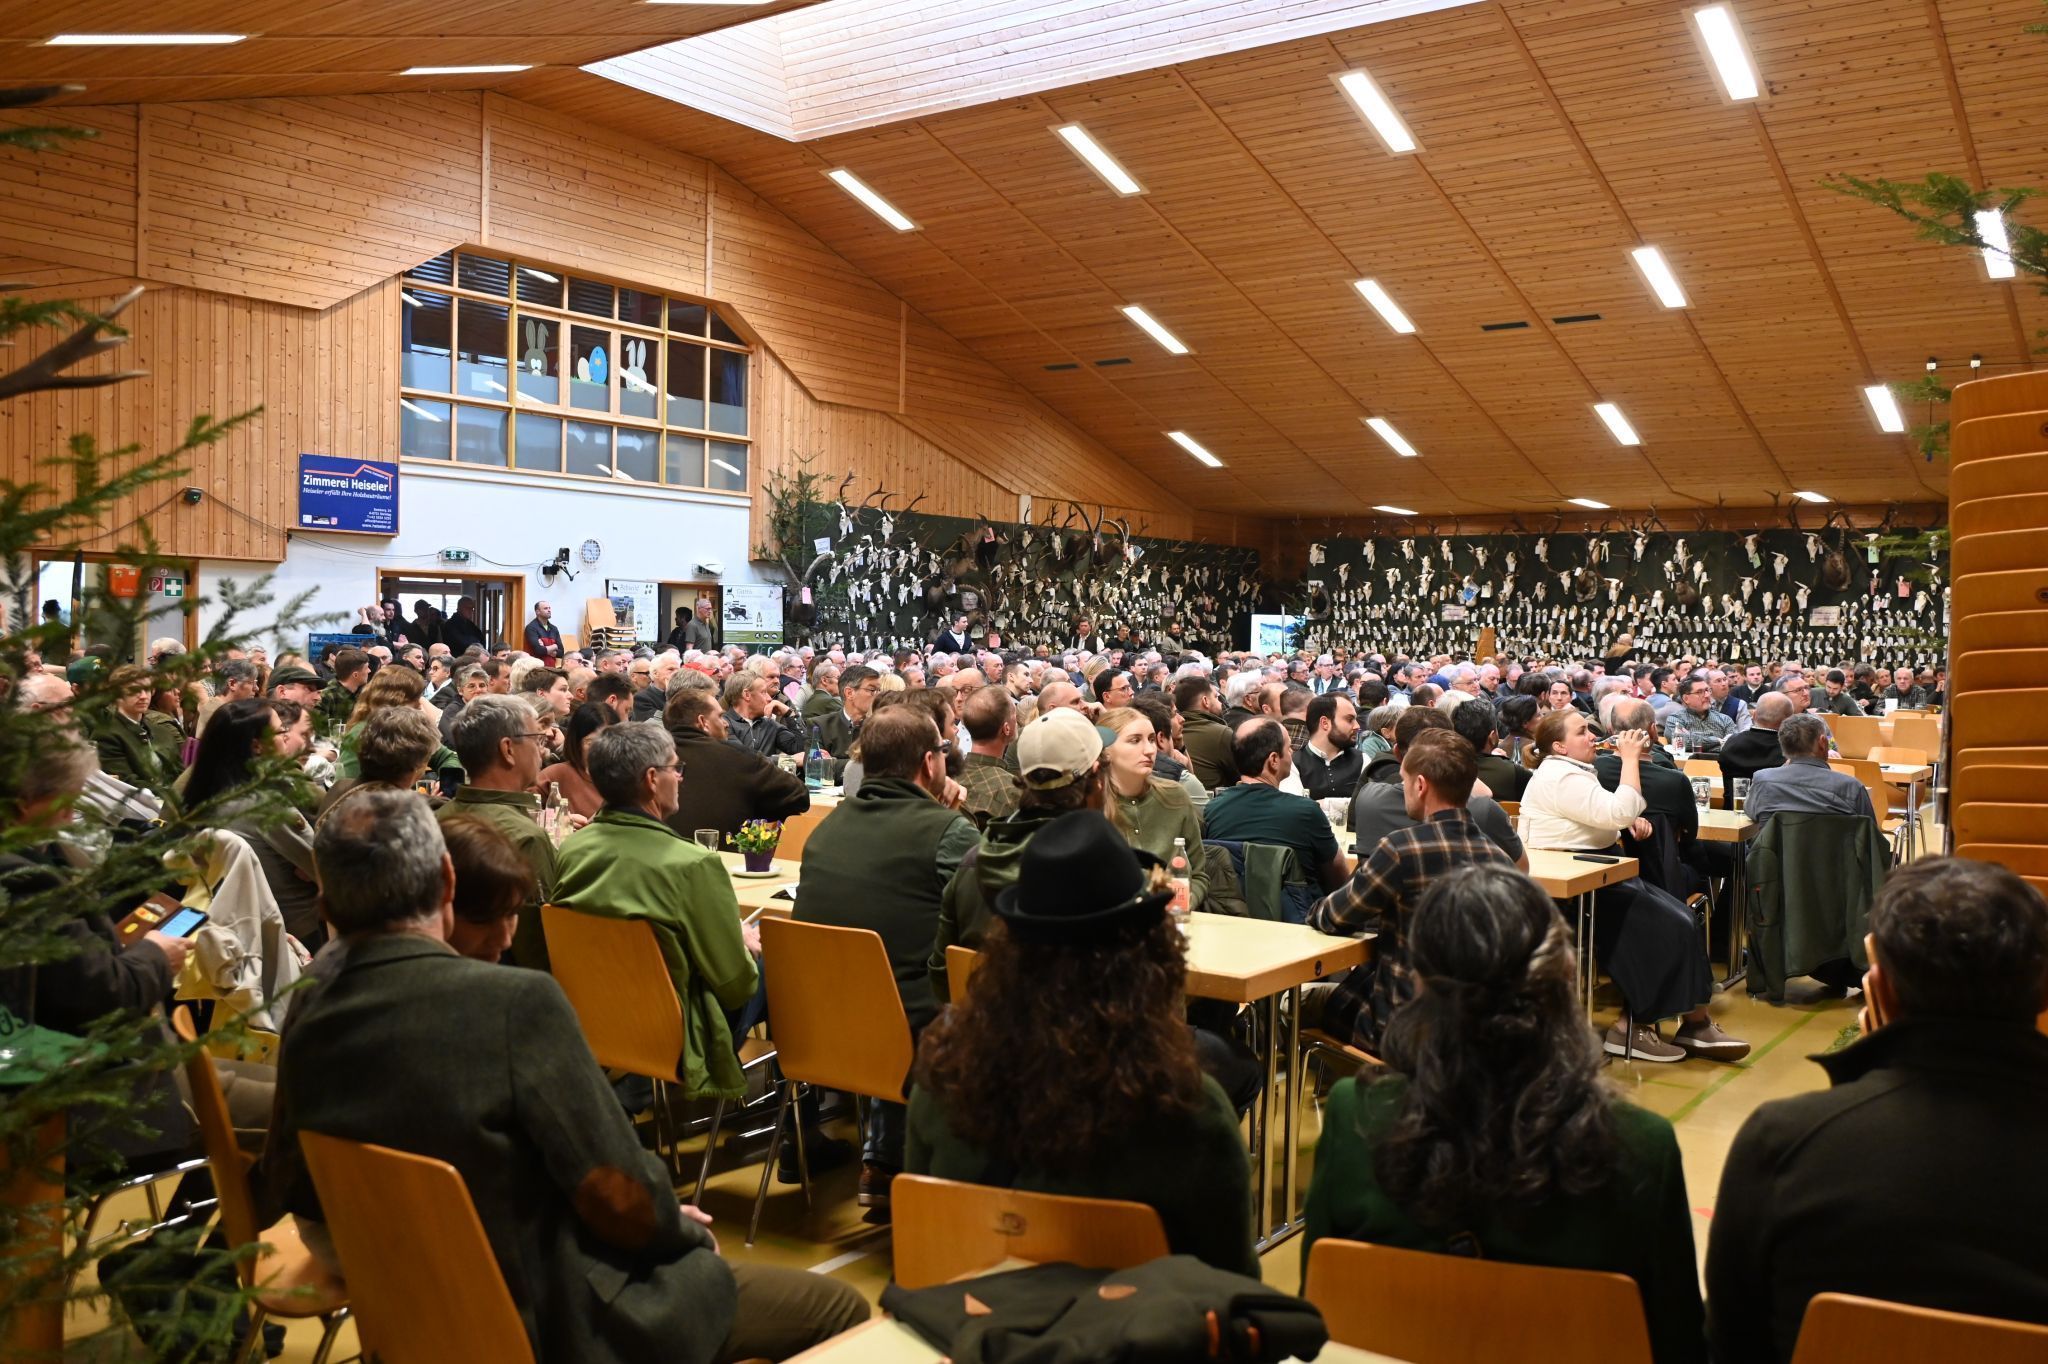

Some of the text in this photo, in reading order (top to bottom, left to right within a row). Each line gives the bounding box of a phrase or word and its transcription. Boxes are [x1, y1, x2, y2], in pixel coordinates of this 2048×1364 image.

[303, 474, 389, 492] Zimmerei Heiseler
[324, 489, 341, 497] erfüllt
